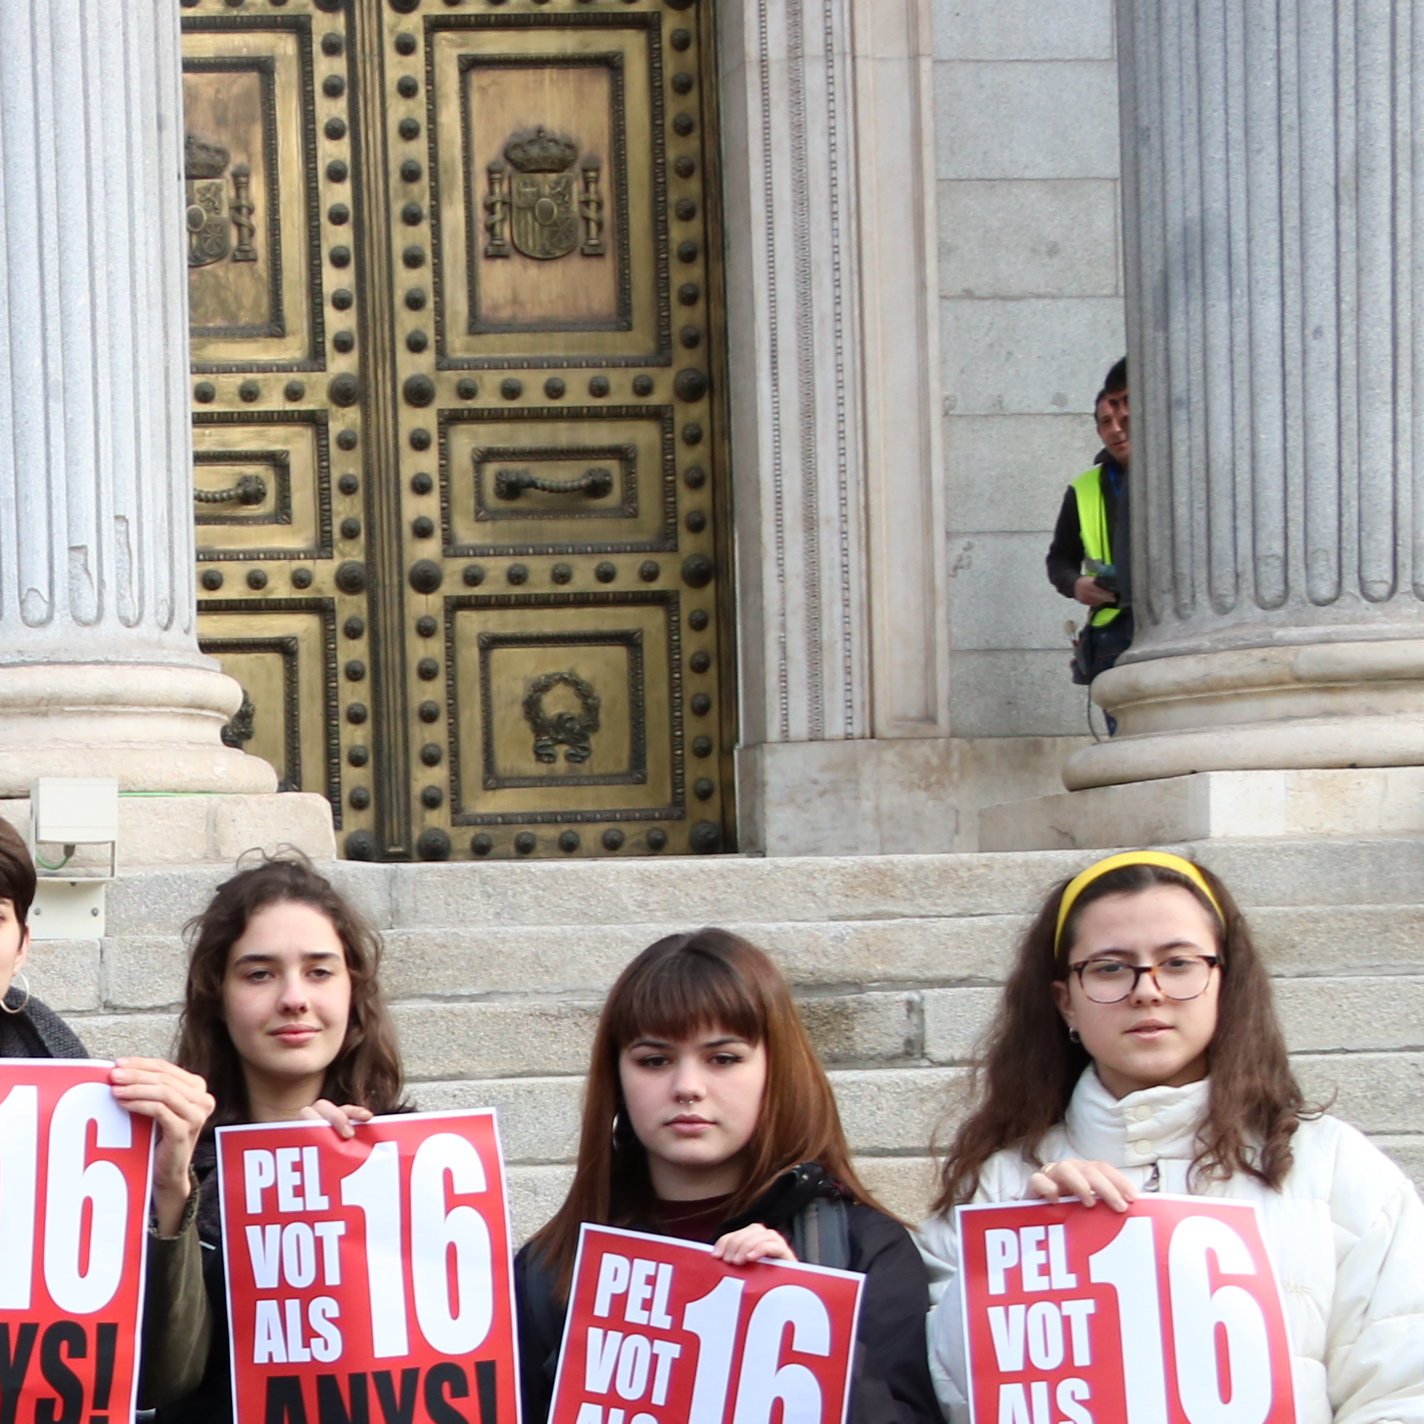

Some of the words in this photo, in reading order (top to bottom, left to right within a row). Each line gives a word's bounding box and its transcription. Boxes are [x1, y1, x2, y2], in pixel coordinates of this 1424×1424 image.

[244, 1146, 329, 1214] PEL
[245, 1220, 346, 1289] VOT
[340, 1132, 494, 1358] 16
[984, 1224, 1076, 1295] PEL
[593, 1252, 673, 1329] PEL
[253, 1296, 343, 1364] ALS
[986, 1299, 1095, 1373] VOT
[585, 1327, 681, 1407] VOT
